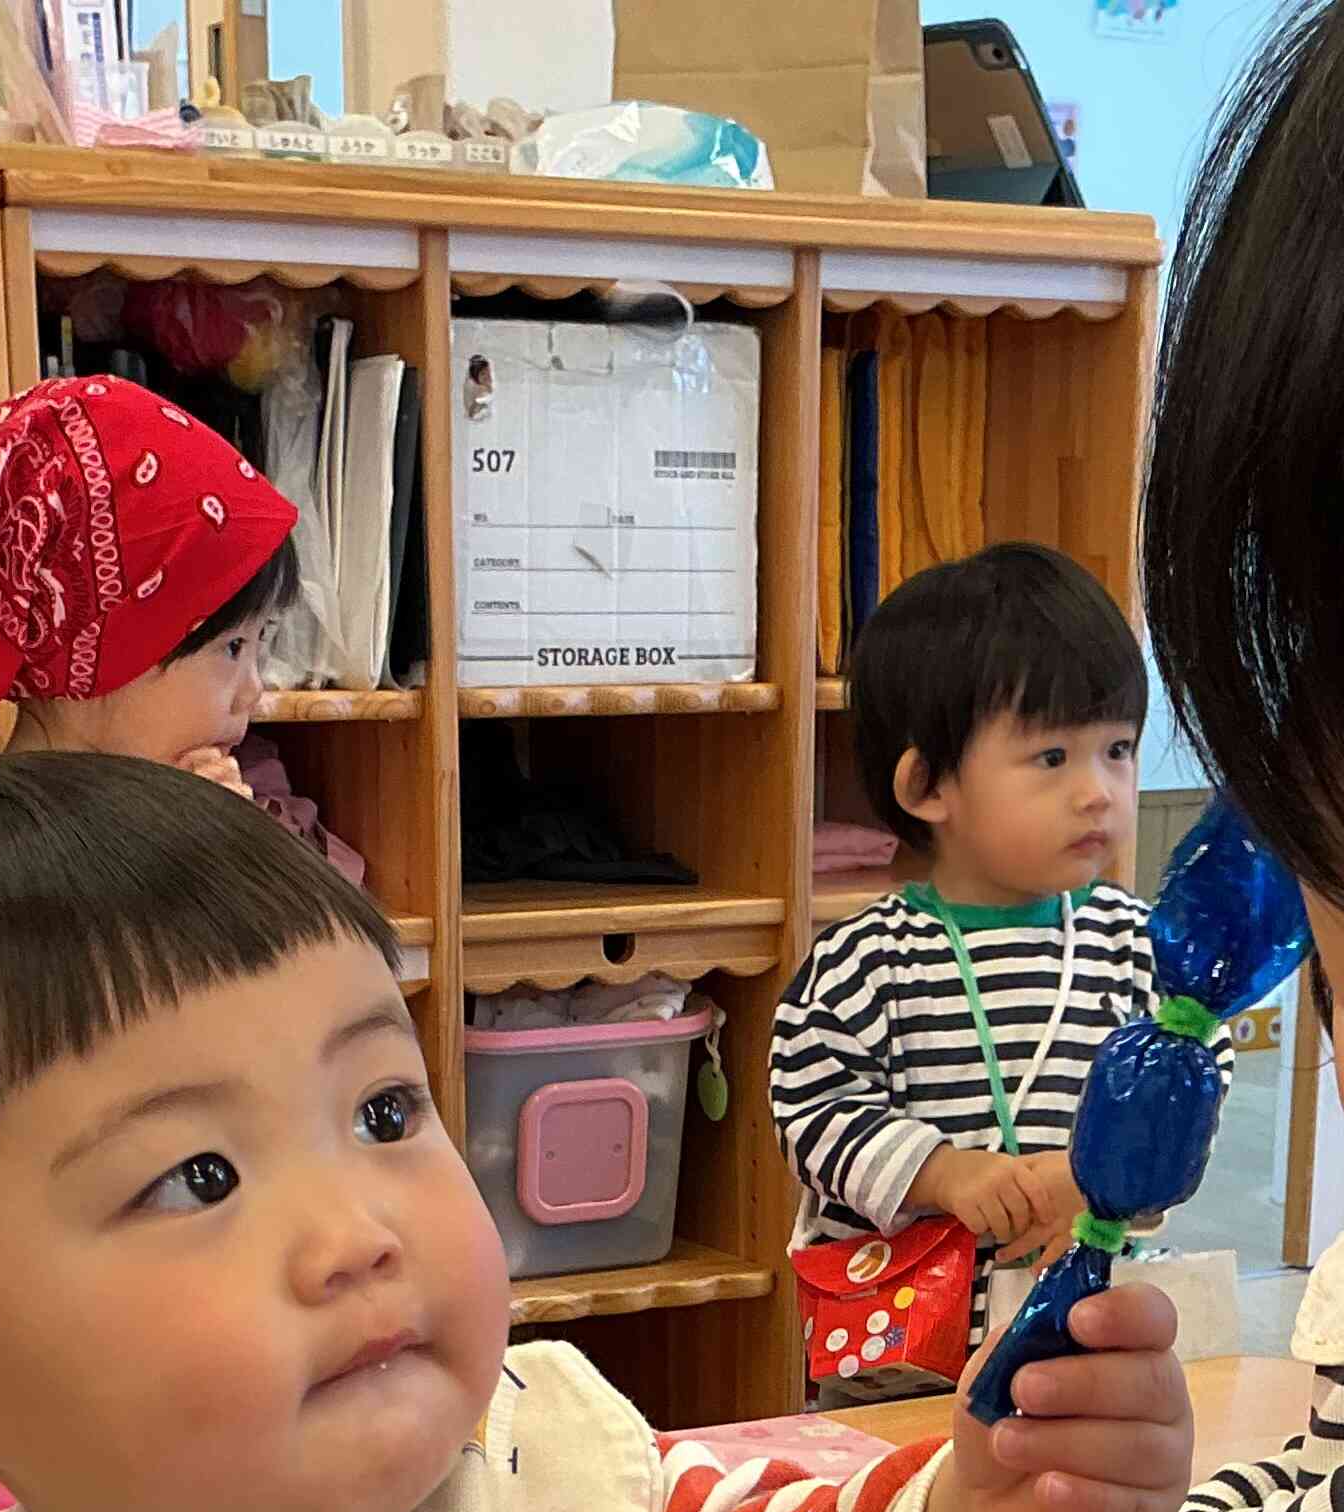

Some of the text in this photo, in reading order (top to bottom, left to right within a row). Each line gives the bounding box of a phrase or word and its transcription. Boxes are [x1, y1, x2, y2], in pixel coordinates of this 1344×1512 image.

[472, 447, 515, 472] 507
[537, 646, 676, 666] STORAGE BOX
